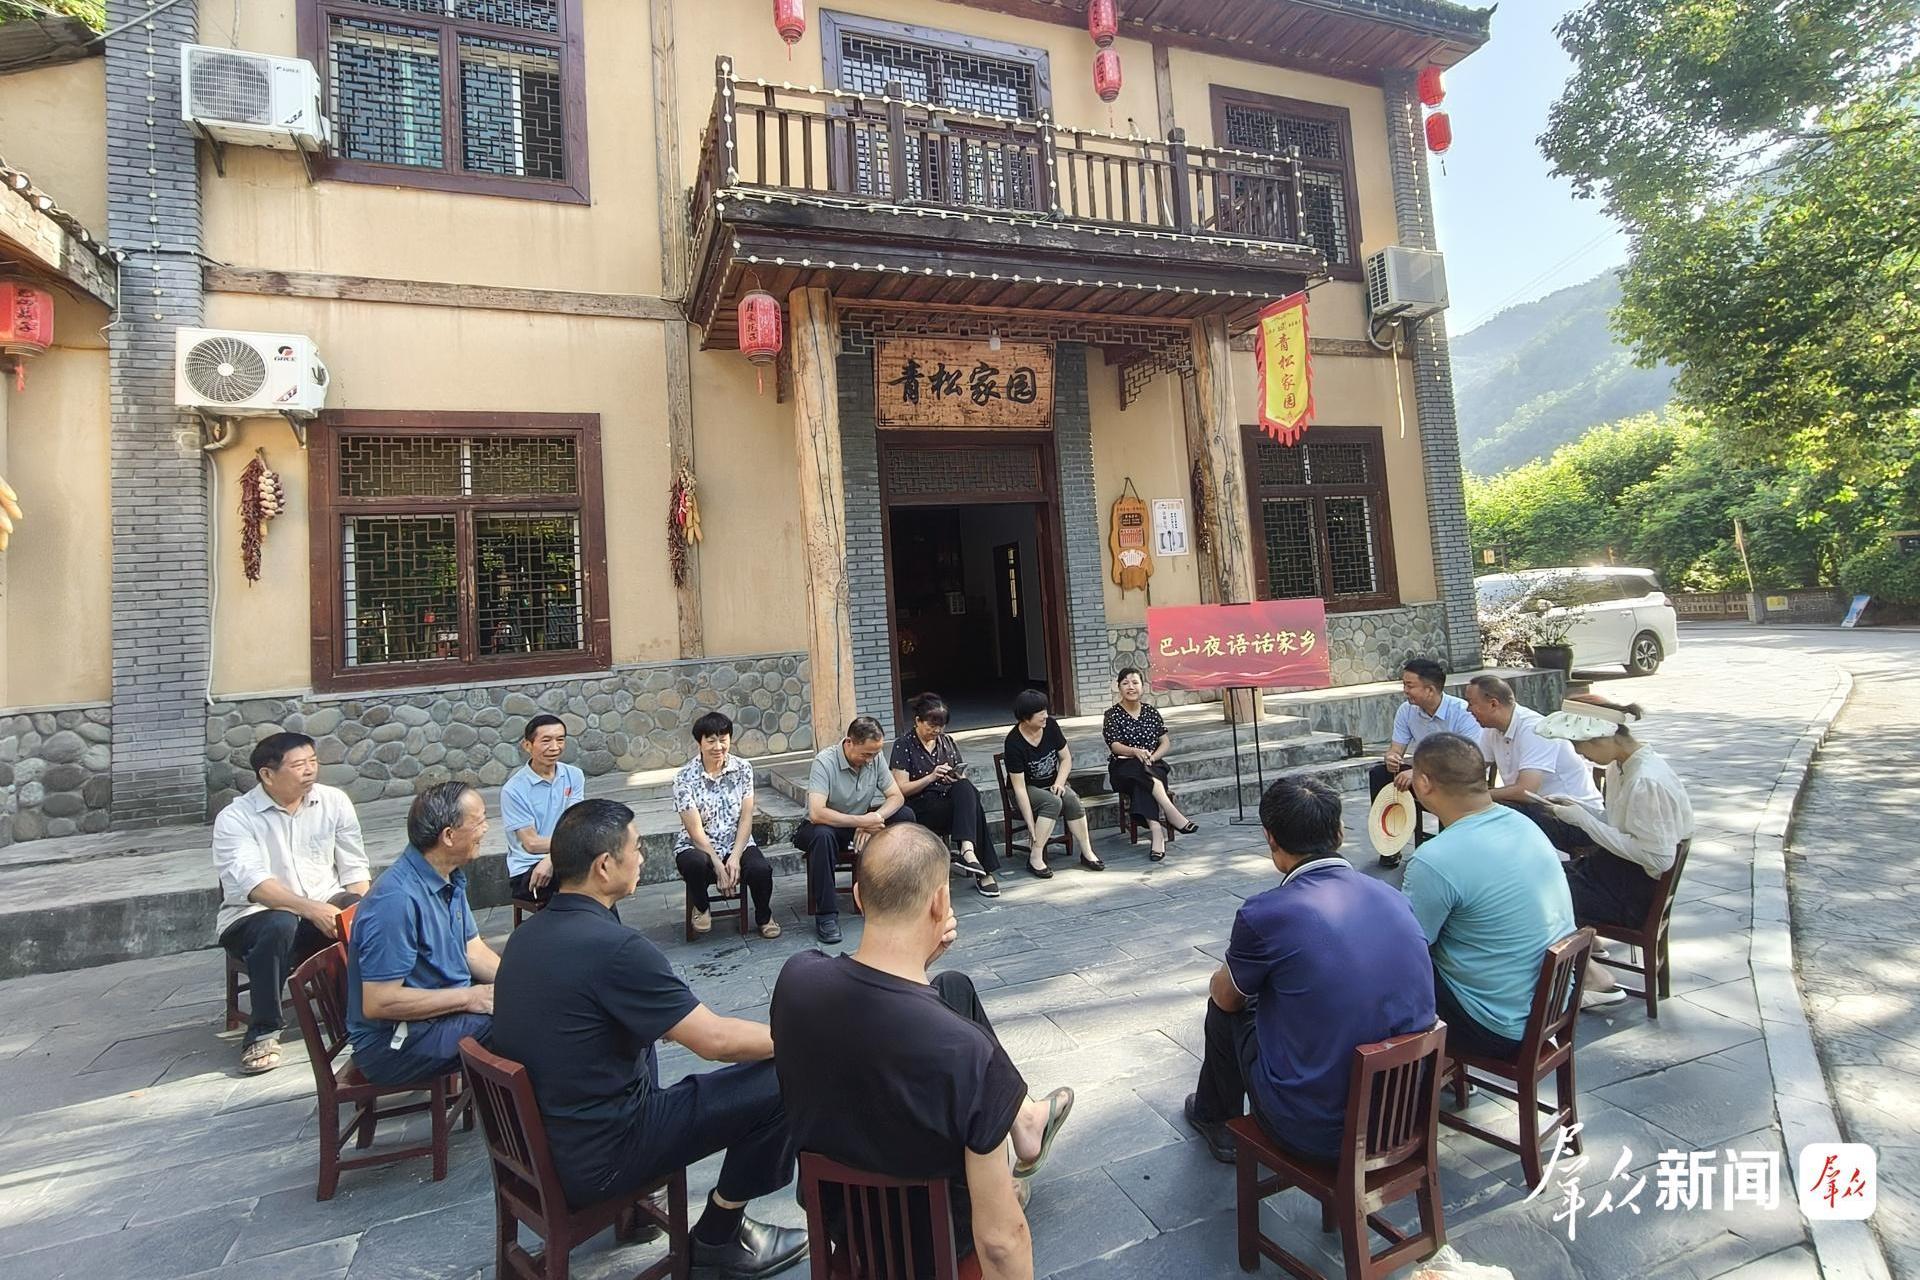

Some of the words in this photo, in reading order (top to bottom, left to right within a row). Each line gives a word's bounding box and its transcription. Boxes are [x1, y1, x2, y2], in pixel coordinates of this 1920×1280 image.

[887, 358, 1038, 407] 青松家园
[1275, 333, 1296, 409] 青松家园
[1159, 630, 1317, 658] 巴山夜语话家乡
